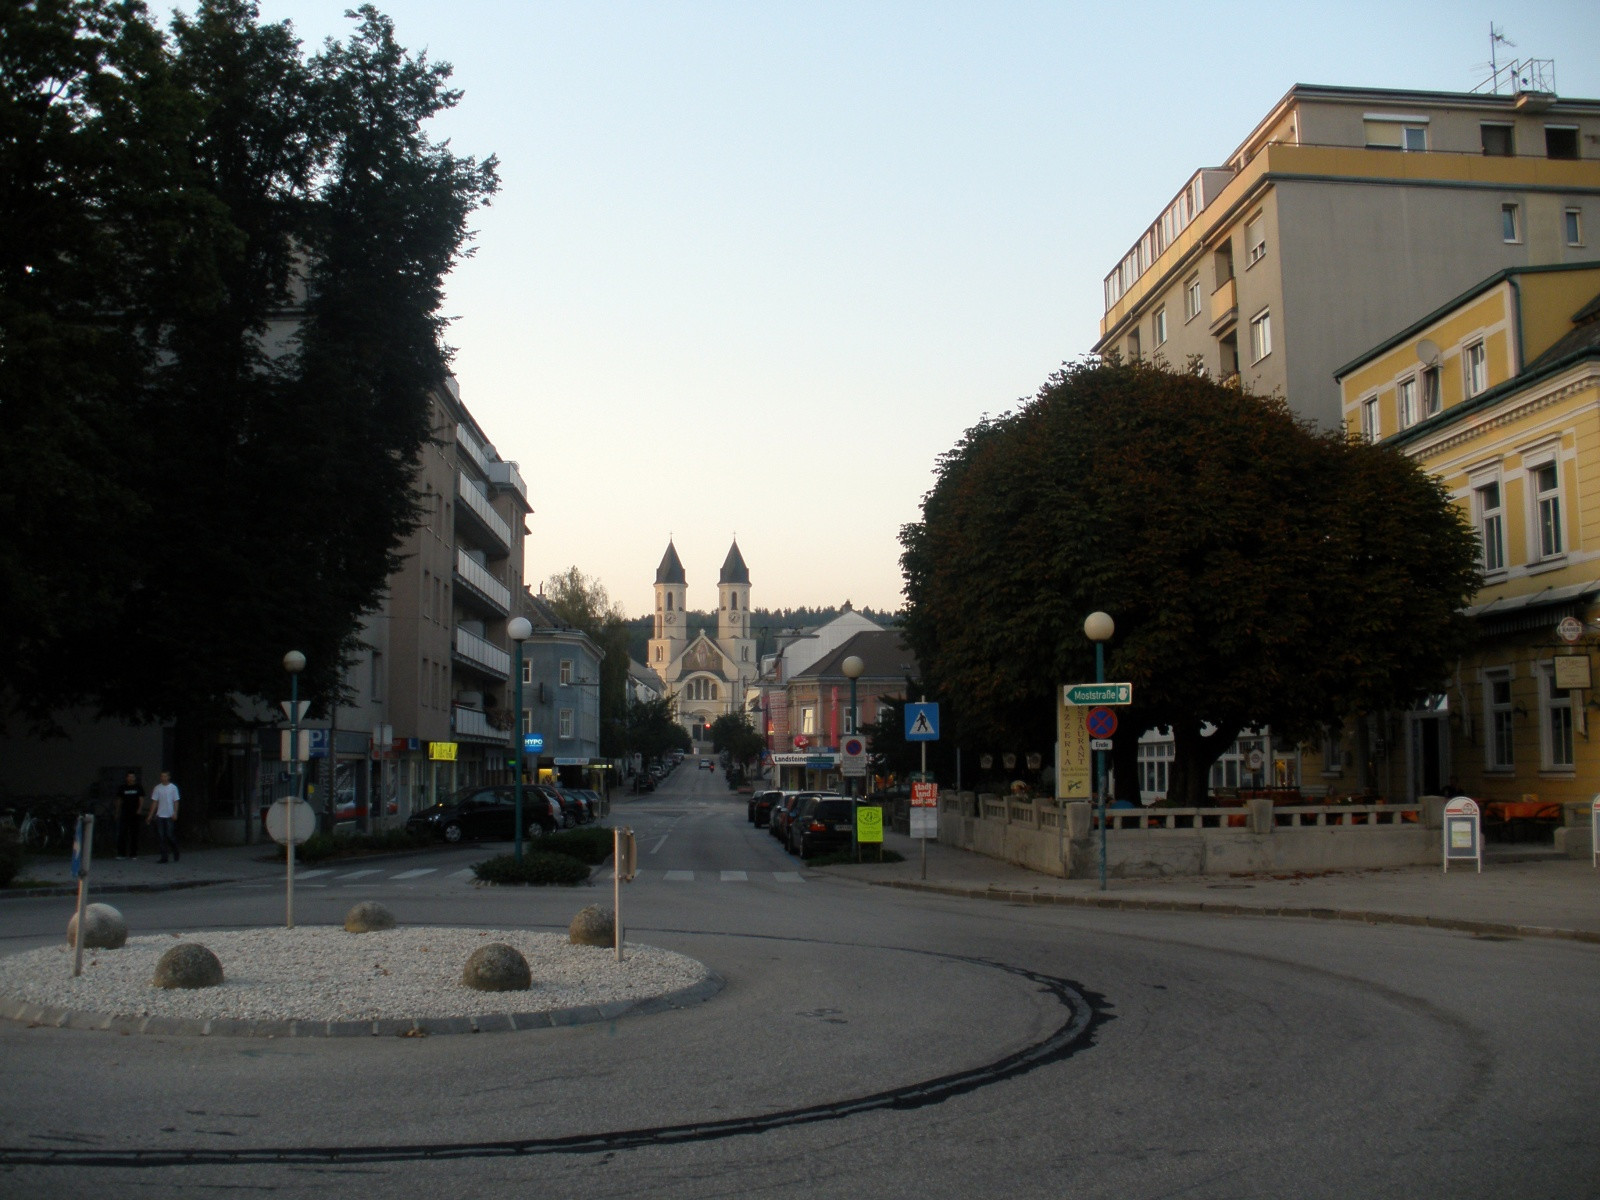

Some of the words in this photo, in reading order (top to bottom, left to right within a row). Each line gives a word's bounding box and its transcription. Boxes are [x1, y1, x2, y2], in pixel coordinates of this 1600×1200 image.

[1074, 690, 1116, 700] Moststraße
[1064, 705, 1072, 765] IZZERIA
[914, 783, 931, 791] stadt
